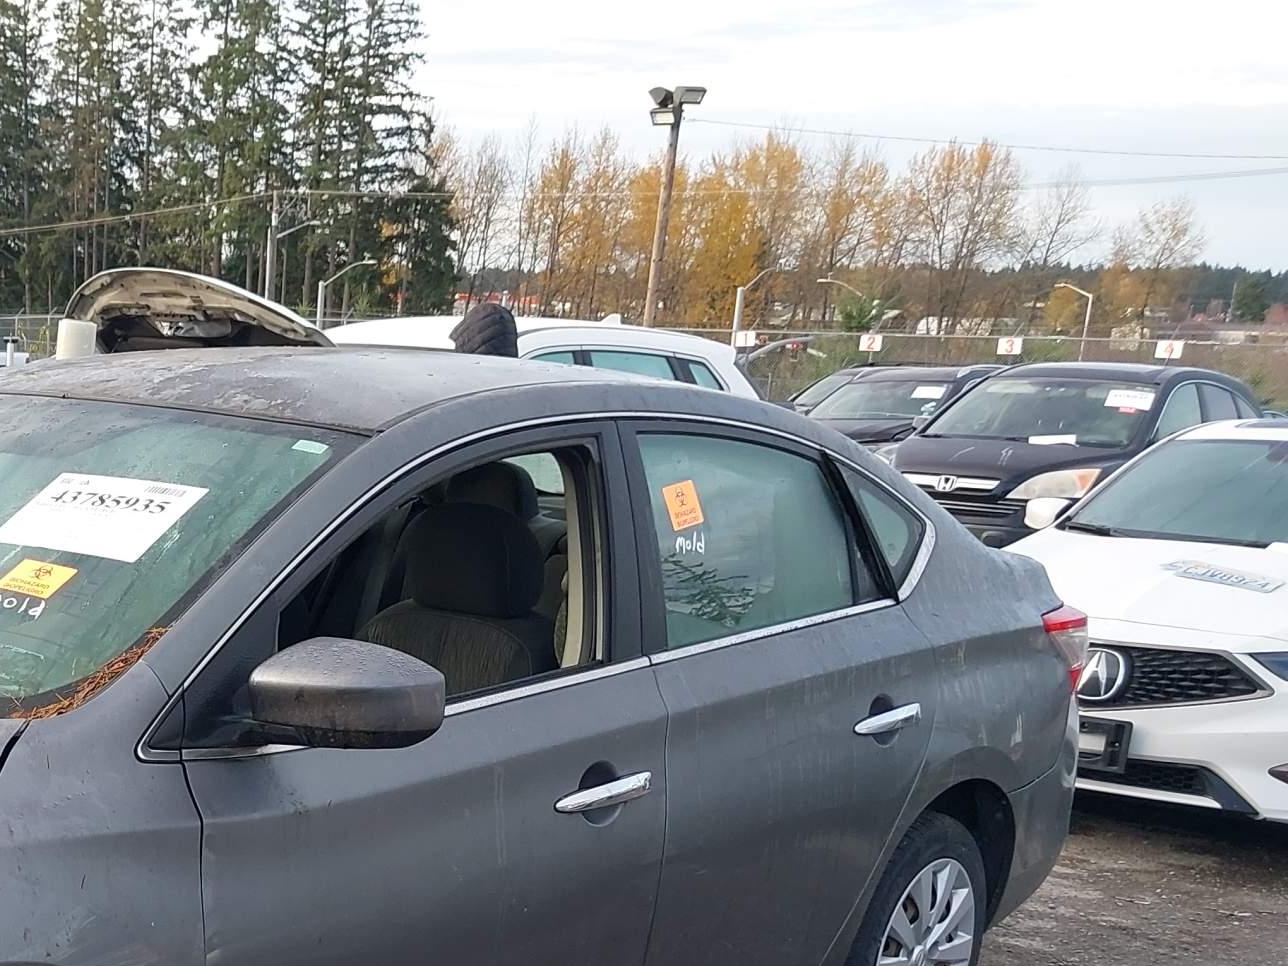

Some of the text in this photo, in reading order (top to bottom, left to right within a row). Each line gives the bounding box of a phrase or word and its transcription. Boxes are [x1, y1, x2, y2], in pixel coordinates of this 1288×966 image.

[865, 337, 876, 351] 2
[1005, 339, 1015, 353] 3
[50, 490, 173, 514] 43785935
